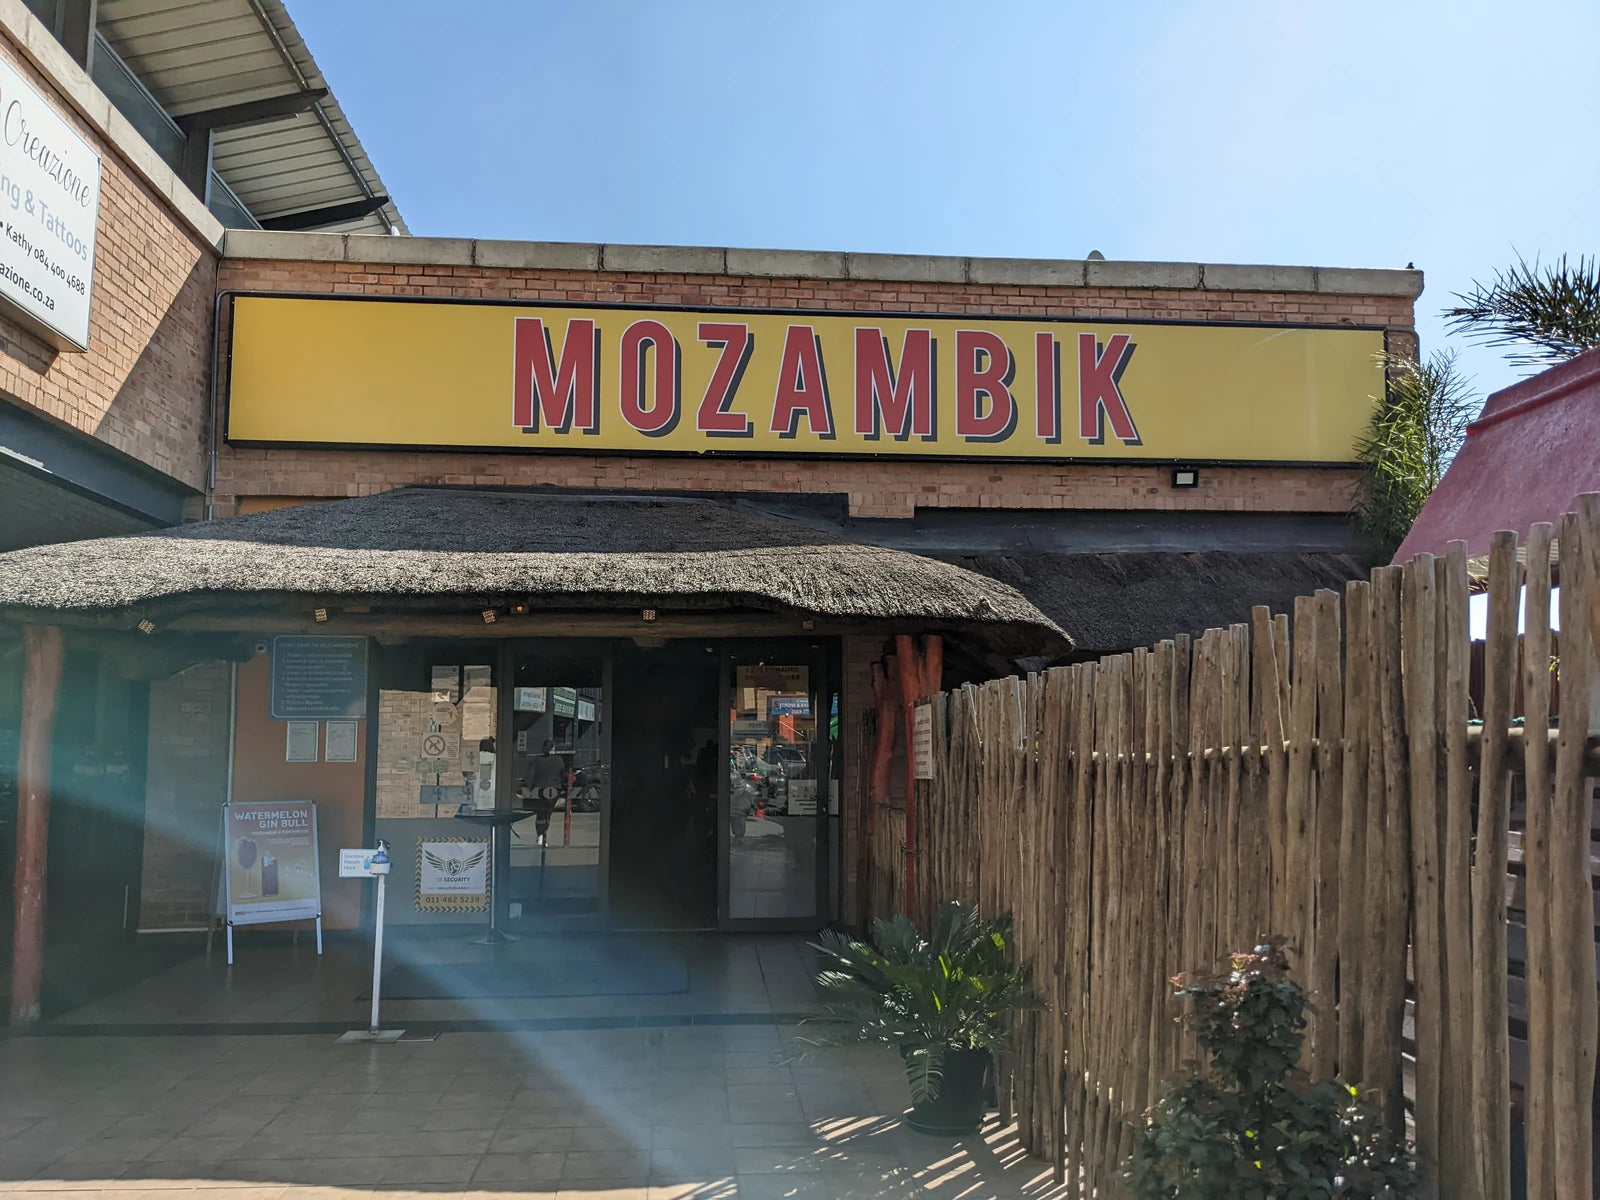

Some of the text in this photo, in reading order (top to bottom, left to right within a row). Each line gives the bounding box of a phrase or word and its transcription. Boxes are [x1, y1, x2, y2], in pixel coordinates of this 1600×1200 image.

[5, 100, 91, 207] Creazione
[25, 189, 35, 216] &
[39, 200, 88, 261] Tattoos
[0, 263, 55, 311] azione.co.za
[6, 223, 85, 296] Kathy 084 400 4688
[513, 317, 1142, 446] MOZAMBIK
[234, 810, 308, 821] WATERMELON
[259, 818, 309, 829] GIN BULL
[425, 896, 480, 904] 011 462 5239
